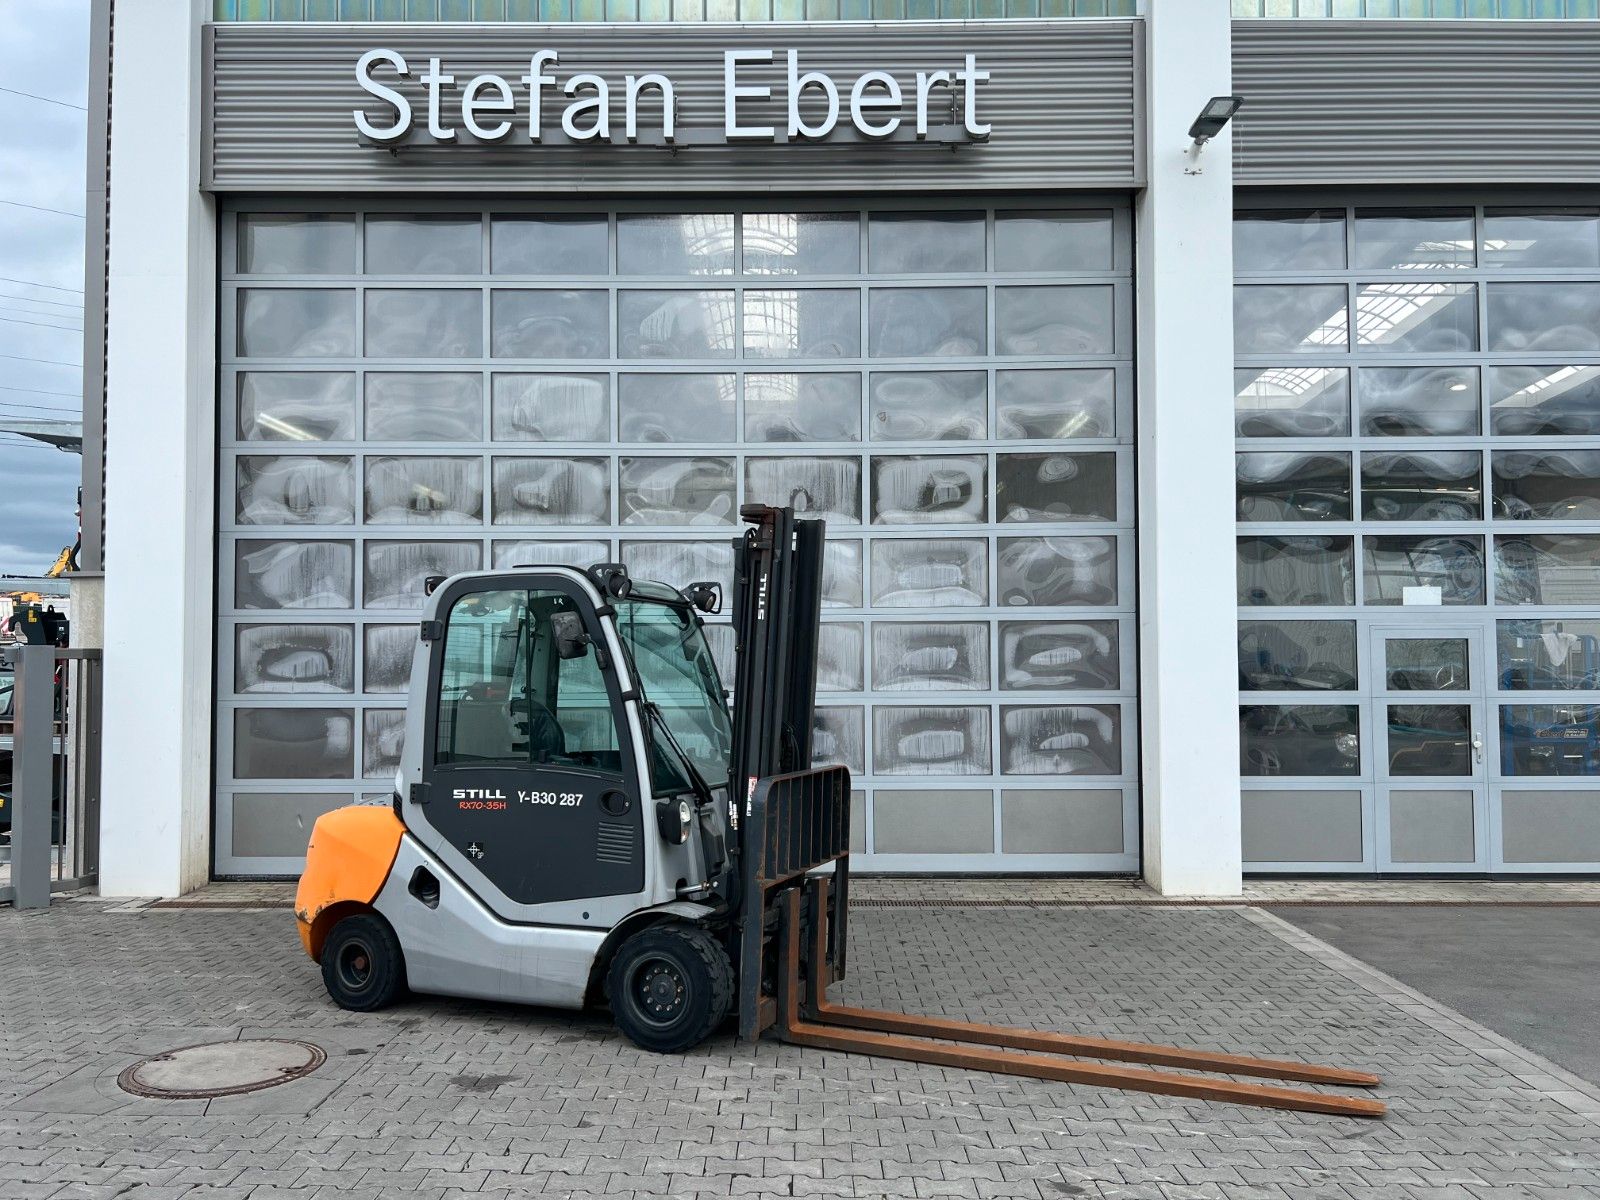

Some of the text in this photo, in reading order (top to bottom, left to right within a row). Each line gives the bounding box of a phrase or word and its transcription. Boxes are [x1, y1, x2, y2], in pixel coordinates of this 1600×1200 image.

[353, 48, 992, 142] Stefan Ebert
[758, 573, 767, 620] STILL
[453, 789, 507, 799] STILL
[518, 790, 584, 807] Y-B30 287
[459, 801, 507, 810] RX70-35H
